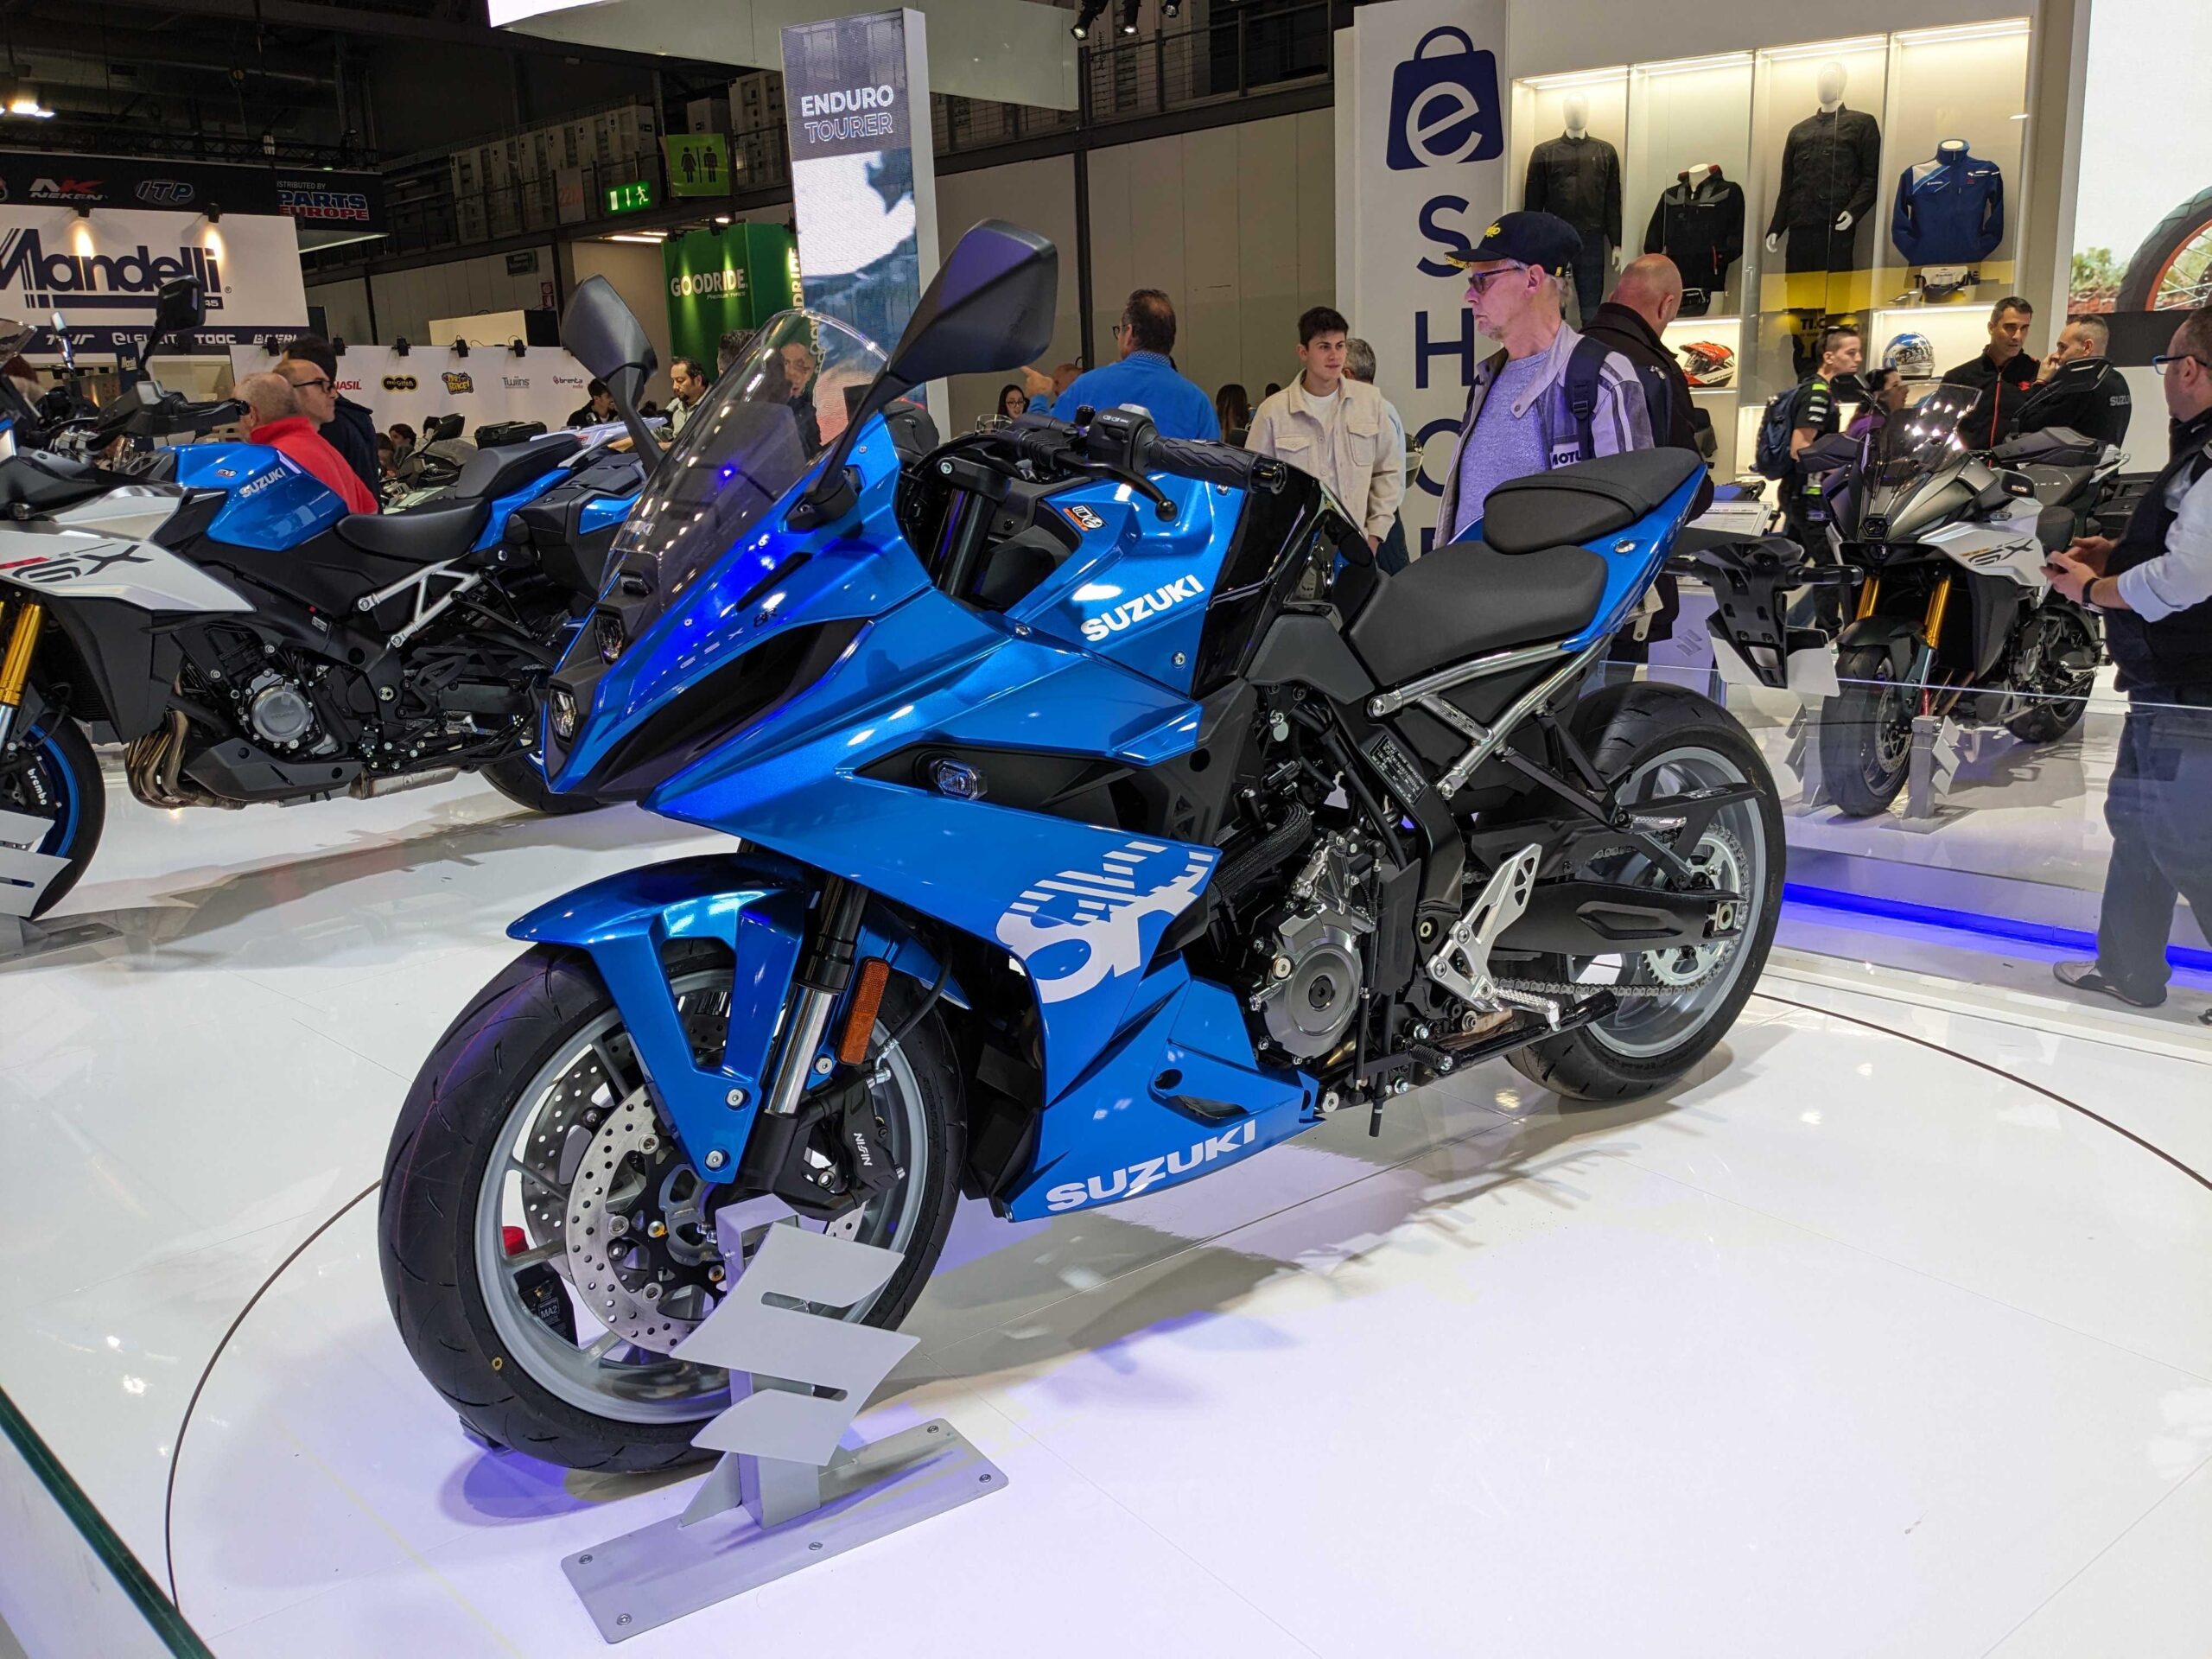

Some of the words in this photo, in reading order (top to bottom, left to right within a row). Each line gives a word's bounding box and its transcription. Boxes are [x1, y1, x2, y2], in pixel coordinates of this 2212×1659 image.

[801, 85, 894, 118] ENDURO
[804, 112, 893, 143] TOURER
[29, 192, 104, 200] NEKEN
[136, 181, 194, 201] ITP
[276, 190, 367, 209] PARTS
[278, 205, 369, 220] EUROPE
[671, 268, 746, 297] GOODRIDE
[239, 467, 286, 498] SUZUKI
[1080, 574, 1205, 641] SUZUKI
[28, 768, 47, 804] brembo
[1046, 1120, 1255, 1211] SUZUKI
[540, 1305, 557, 1319] MA2
